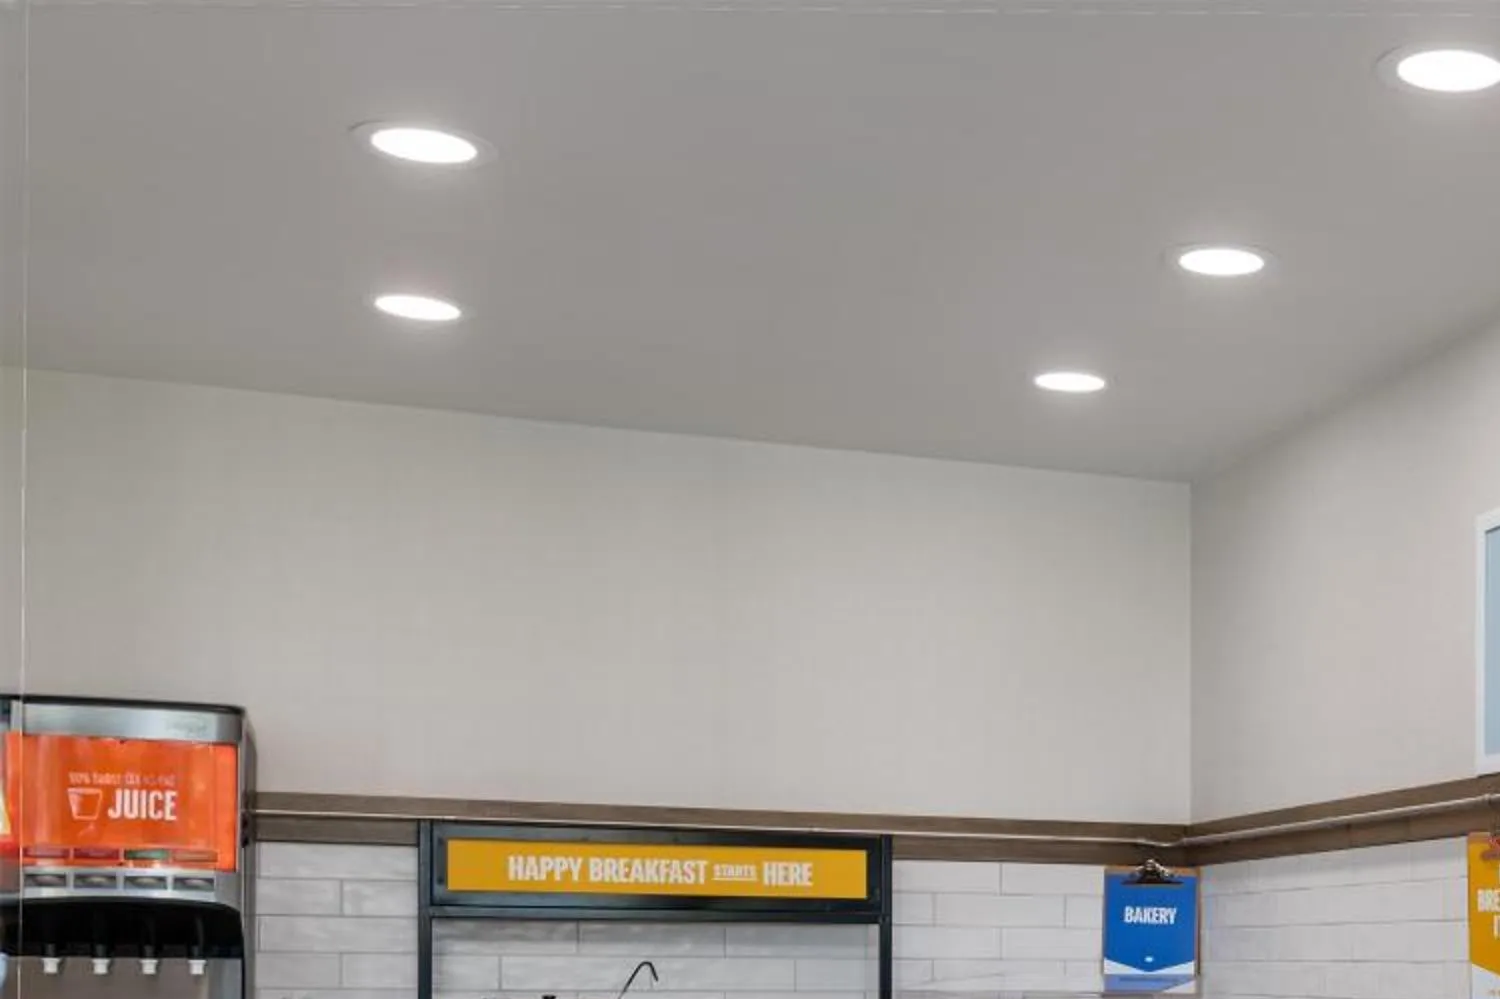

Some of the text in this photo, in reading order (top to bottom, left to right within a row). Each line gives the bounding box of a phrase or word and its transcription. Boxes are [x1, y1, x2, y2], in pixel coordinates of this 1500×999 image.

[107, 788, 178, 821] JUICE
[508, 855, 813, 887] HAPPY BREAKFAST STARTS HERE
[1124, 905, 1177, 925] BAKERY
